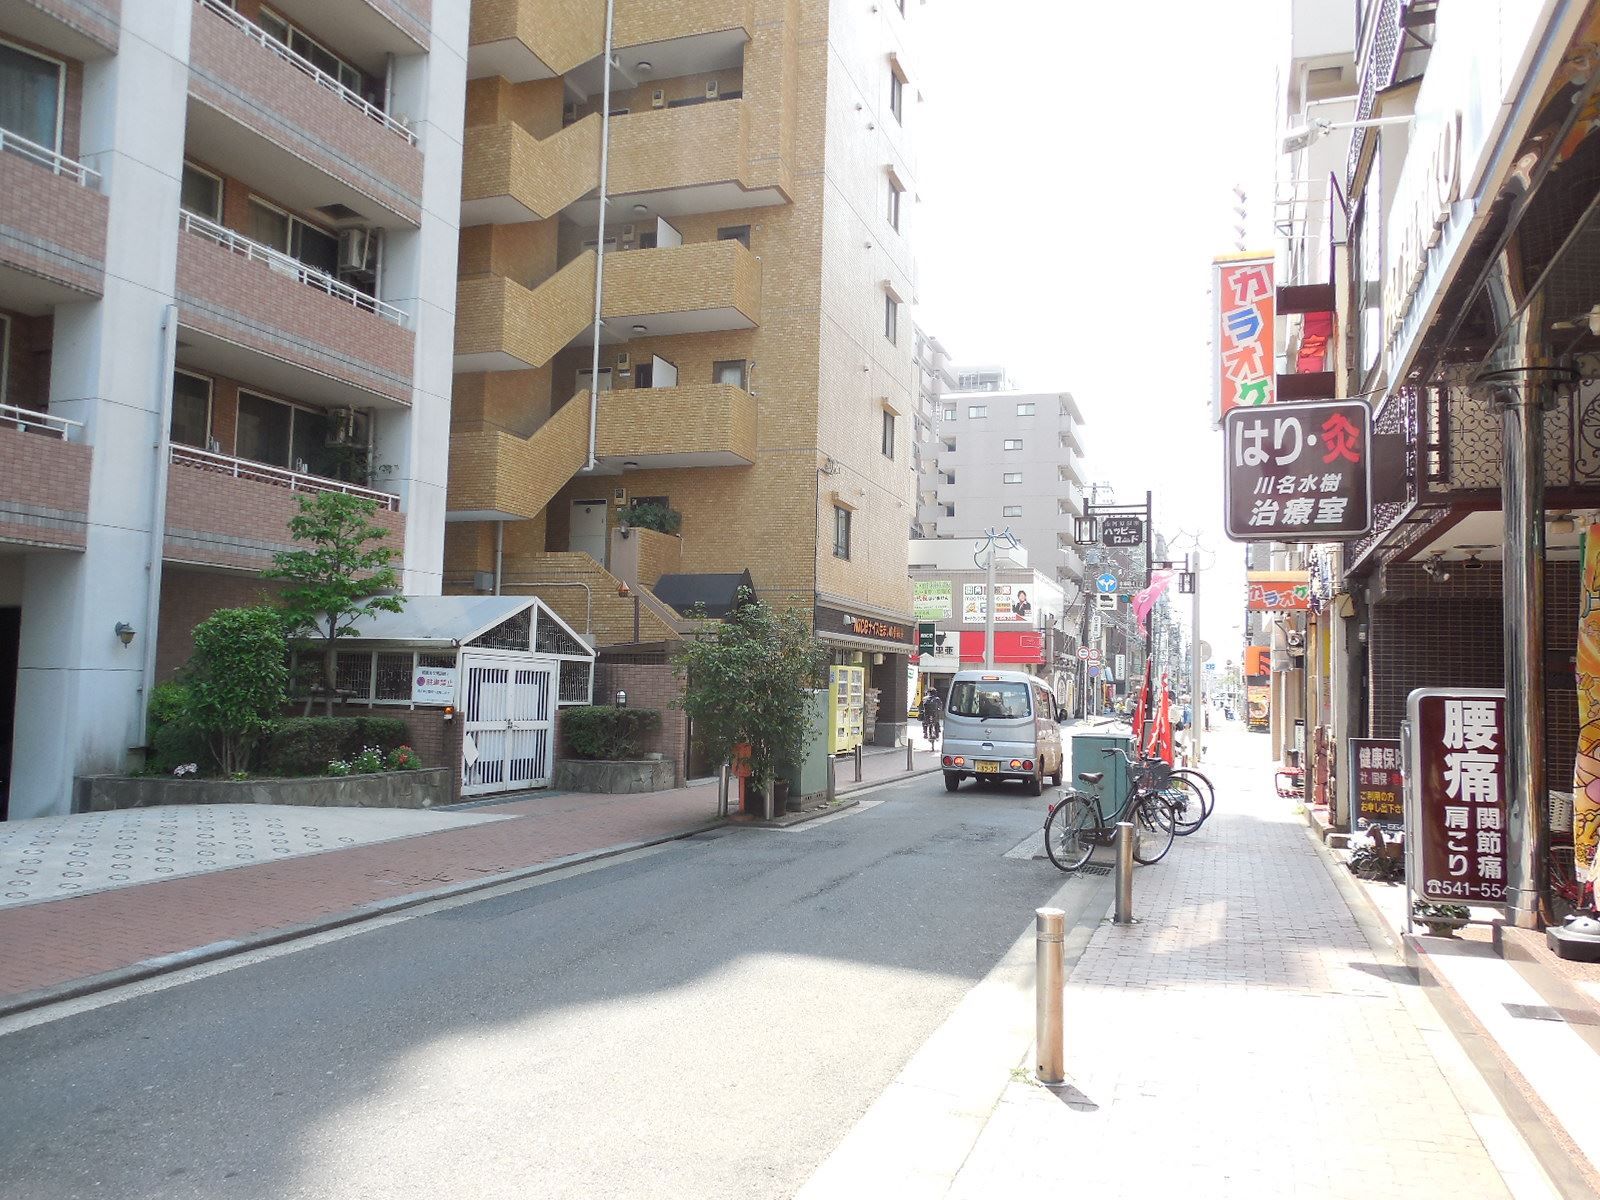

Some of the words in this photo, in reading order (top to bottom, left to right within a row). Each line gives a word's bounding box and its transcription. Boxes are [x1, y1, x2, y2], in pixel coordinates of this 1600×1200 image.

[1221, 266, 1273, 404] カラオケ
[1235, 413, 1360, 467] はり・灸
[1248, 497, 1348, 526] 治療室
[1253, 473, 1342, 494] 川名水樹
[1248, 585, 1309, 607] カラオケ
[1443, 700, 1499, 803] 腰痛
[1444, 806, 1469, 876] 肩こり
[1476, 807, 1502, 879] 関節痛
